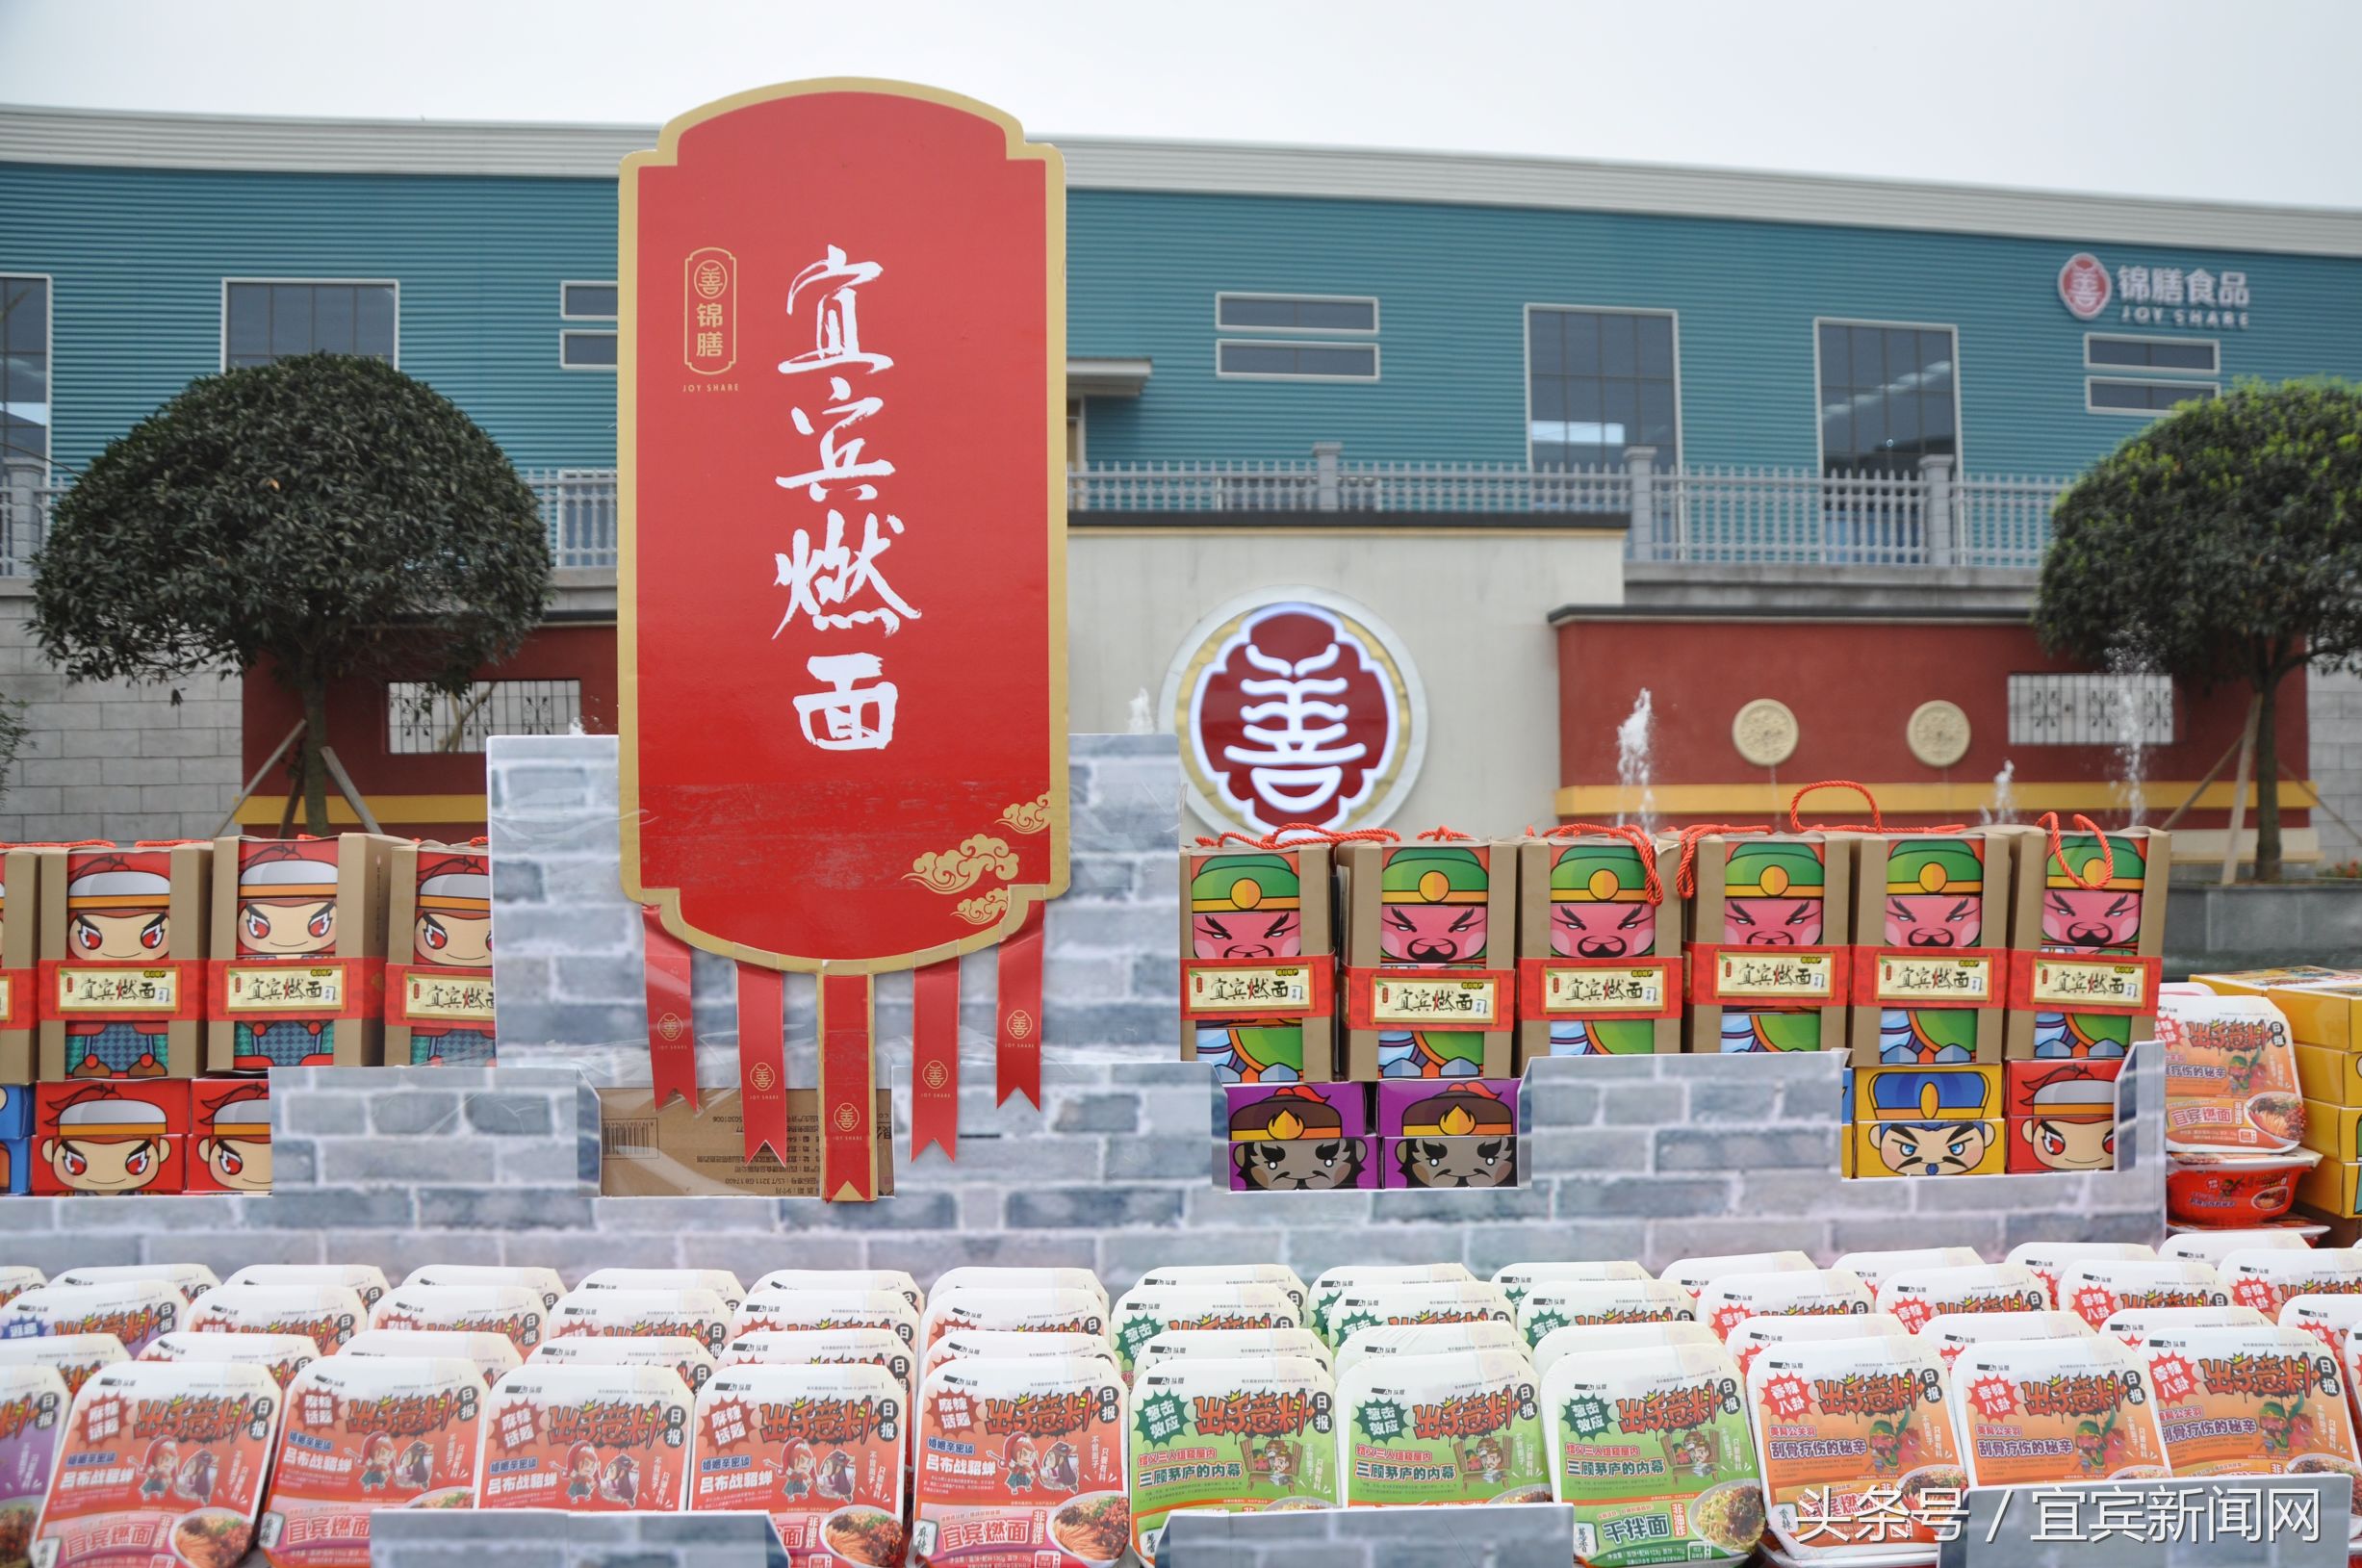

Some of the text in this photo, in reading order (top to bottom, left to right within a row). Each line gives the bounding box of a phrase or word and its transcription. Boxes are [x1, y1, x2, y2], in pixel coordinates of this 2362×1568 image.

[2118, 265, 2249, 307] 锦膳食品
[697, 302, 724, 358] 锦膳
[2121, 305, 2249, 329] JOY SHARE
[706, 383, 739, 392] SHARE
[772, 244, 922, 750] 宜宾燃面
[1737, 963, 1812, 986] 宜宾燃面
[1897, 965, 1969, 990] 宜宾燃面
[2053, 969, 2125, 994] 宜宾燃面
[79, 978, 156, 1001] 宜宾燃面
[247, 977, 322, 1001] 宜宾燃面
[1210, 977, 1289, 1001] 宜宾燃面
[1394, 988, 1474, 1012] 宜宾燃面
[1566, 977, 1643, 1001] 宜宾燃面
[1924, 1371, 1941, 1401] 日报
[2125, 1372, 2144, 1403] 日报
[2319, 1358, 2338, 1395] 日报
[460, 1387, 477, 1420] 日报
[1101, 1388, 1117, 1422] 日报
[1520, 1386, 1536, 1419] 日报
[1723, 1380, 1739, 1413] 日报
[250, 1399, 271, 1438] 日报
[880, 1401, 896, 1439] 日报
[1316, 1395, 1330, 1431] 日报
[666, 1407, 682, 1446] 日报
[1769, 1439, 1867, 1460] 刮骨疗伤的秘辛
[1977, 1438, 2074, 1459] 刮骨疗伤的秘辛
[926, 1453, 997, 1477] 吕布战貂蝉
[1138, 1462, 1244, 1488] 三顾茅庐的内幕
[1355, 1460, 1457, 1483] 三顾茅庐的内幕
[1566, 1457, 1666, 1478] 三顾茅庐的内幕
[700, 1470, 773, 1495] 吕布战貂蝉
[1602, 1513, 1670, 1544] 干拌面
[1671, 1502, 1688, 1538] 非油炸
